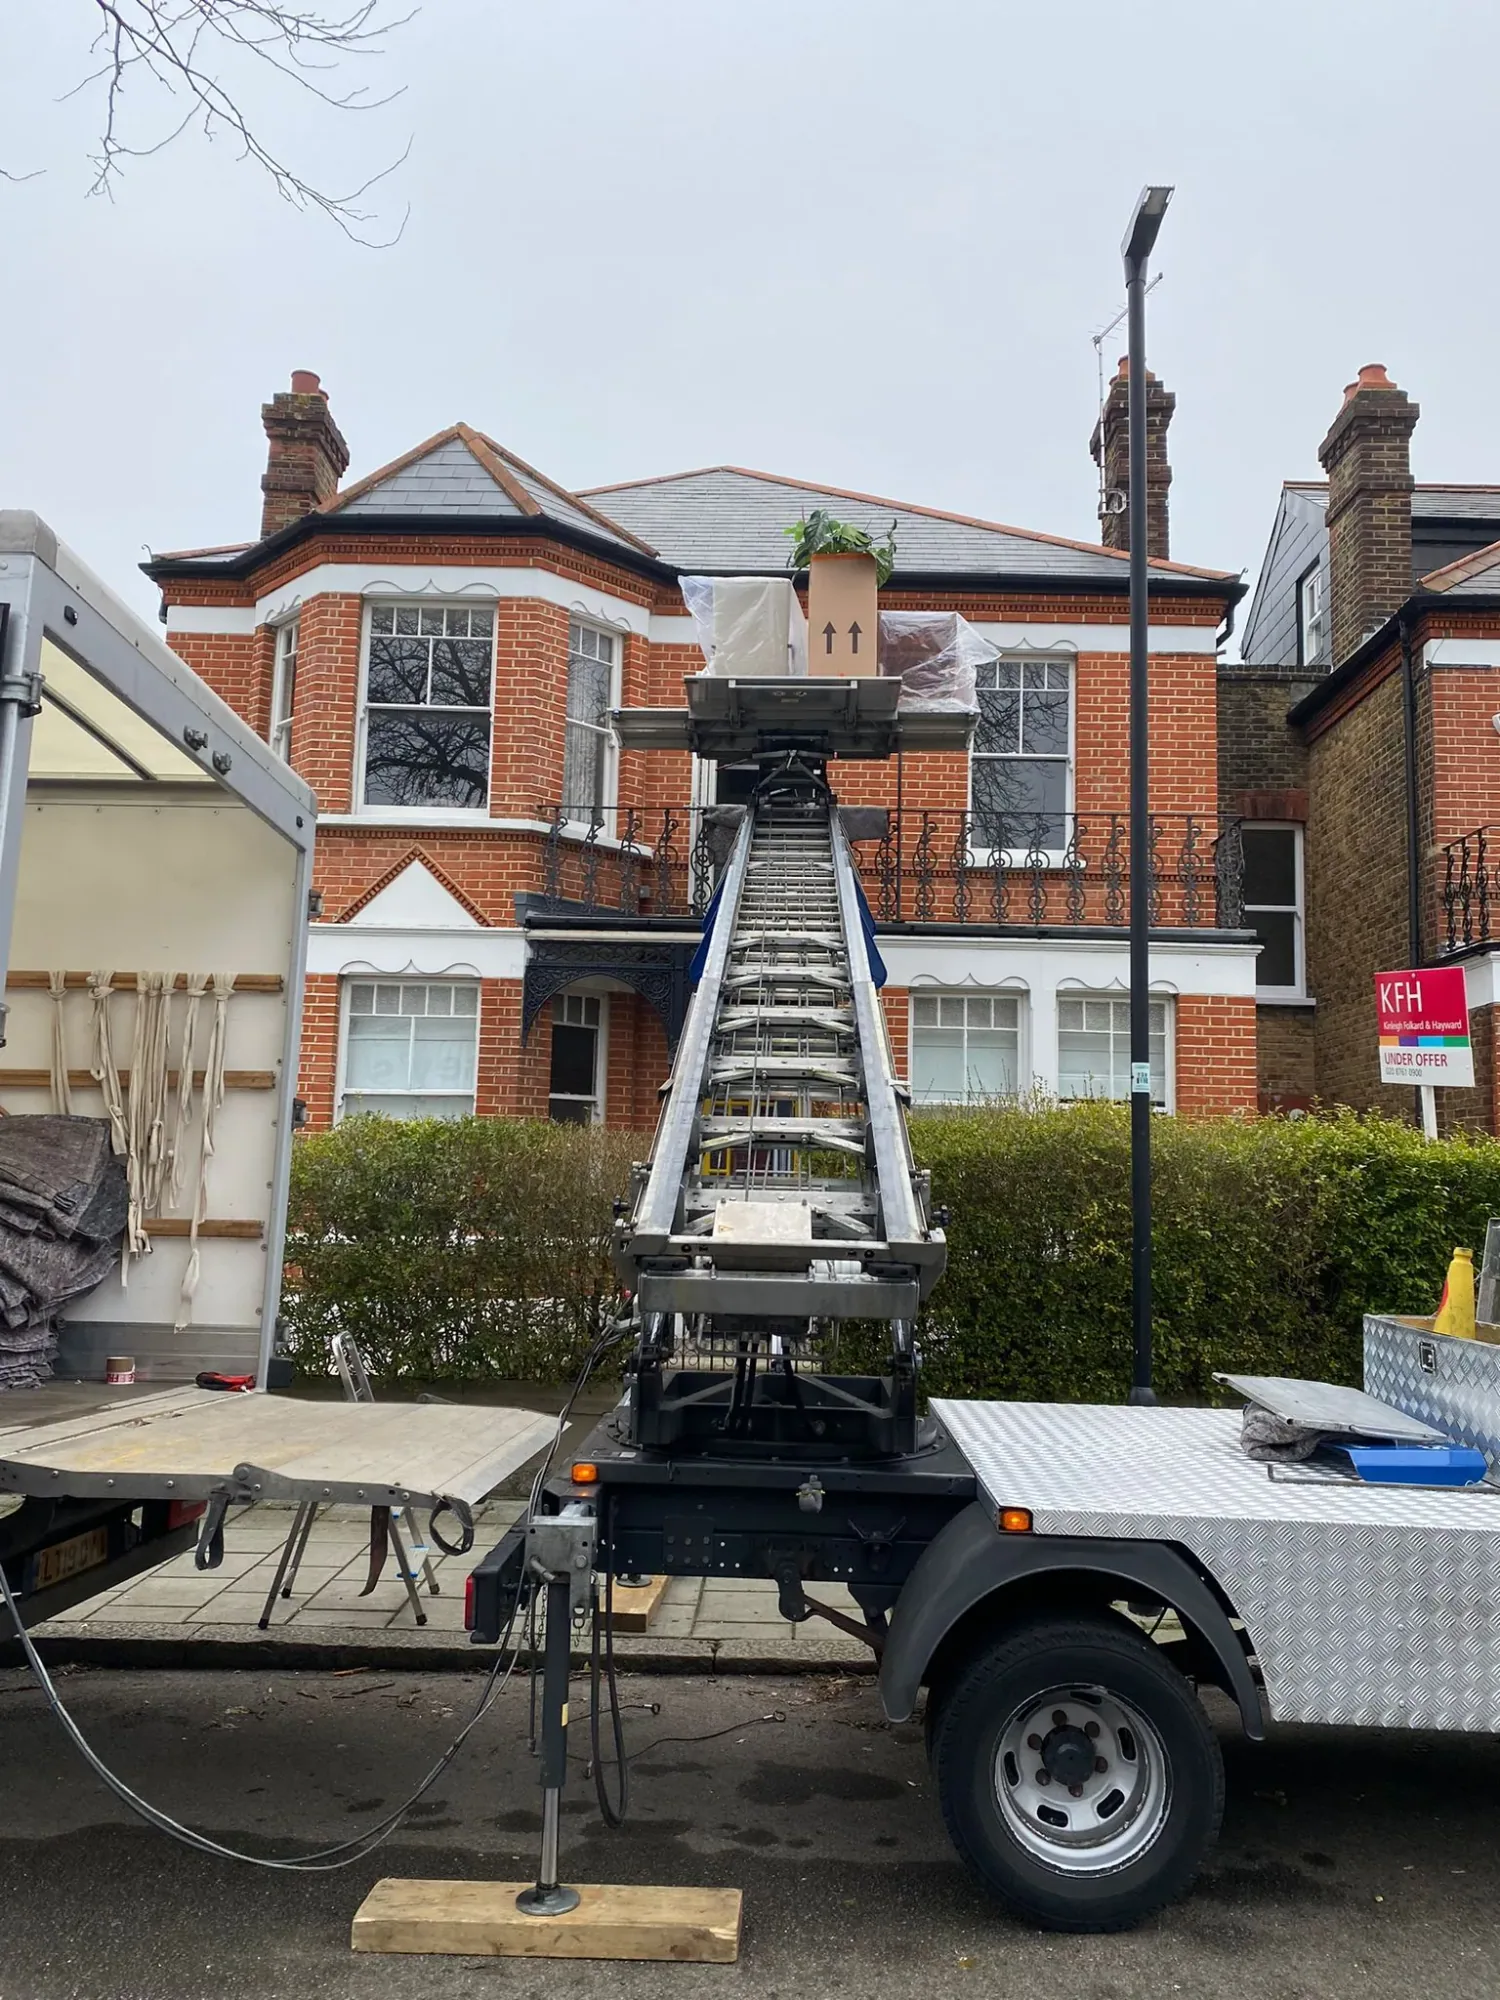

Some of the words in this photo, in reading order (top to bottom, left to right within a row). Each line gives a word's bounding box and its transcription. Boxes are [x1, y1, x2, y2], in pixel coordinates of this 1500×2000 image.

[1380, 980, 1423, 1014] KFH
[1403, 1020, 1424, 1030] Folkard
[1425, 1020, 1431, 1029] &
[1432, 1019, 1462, 1032] Hayward
[1384, 1052, 1413, 1066] UNDER
[1415, 1053, 1448, 1067] OFFER
